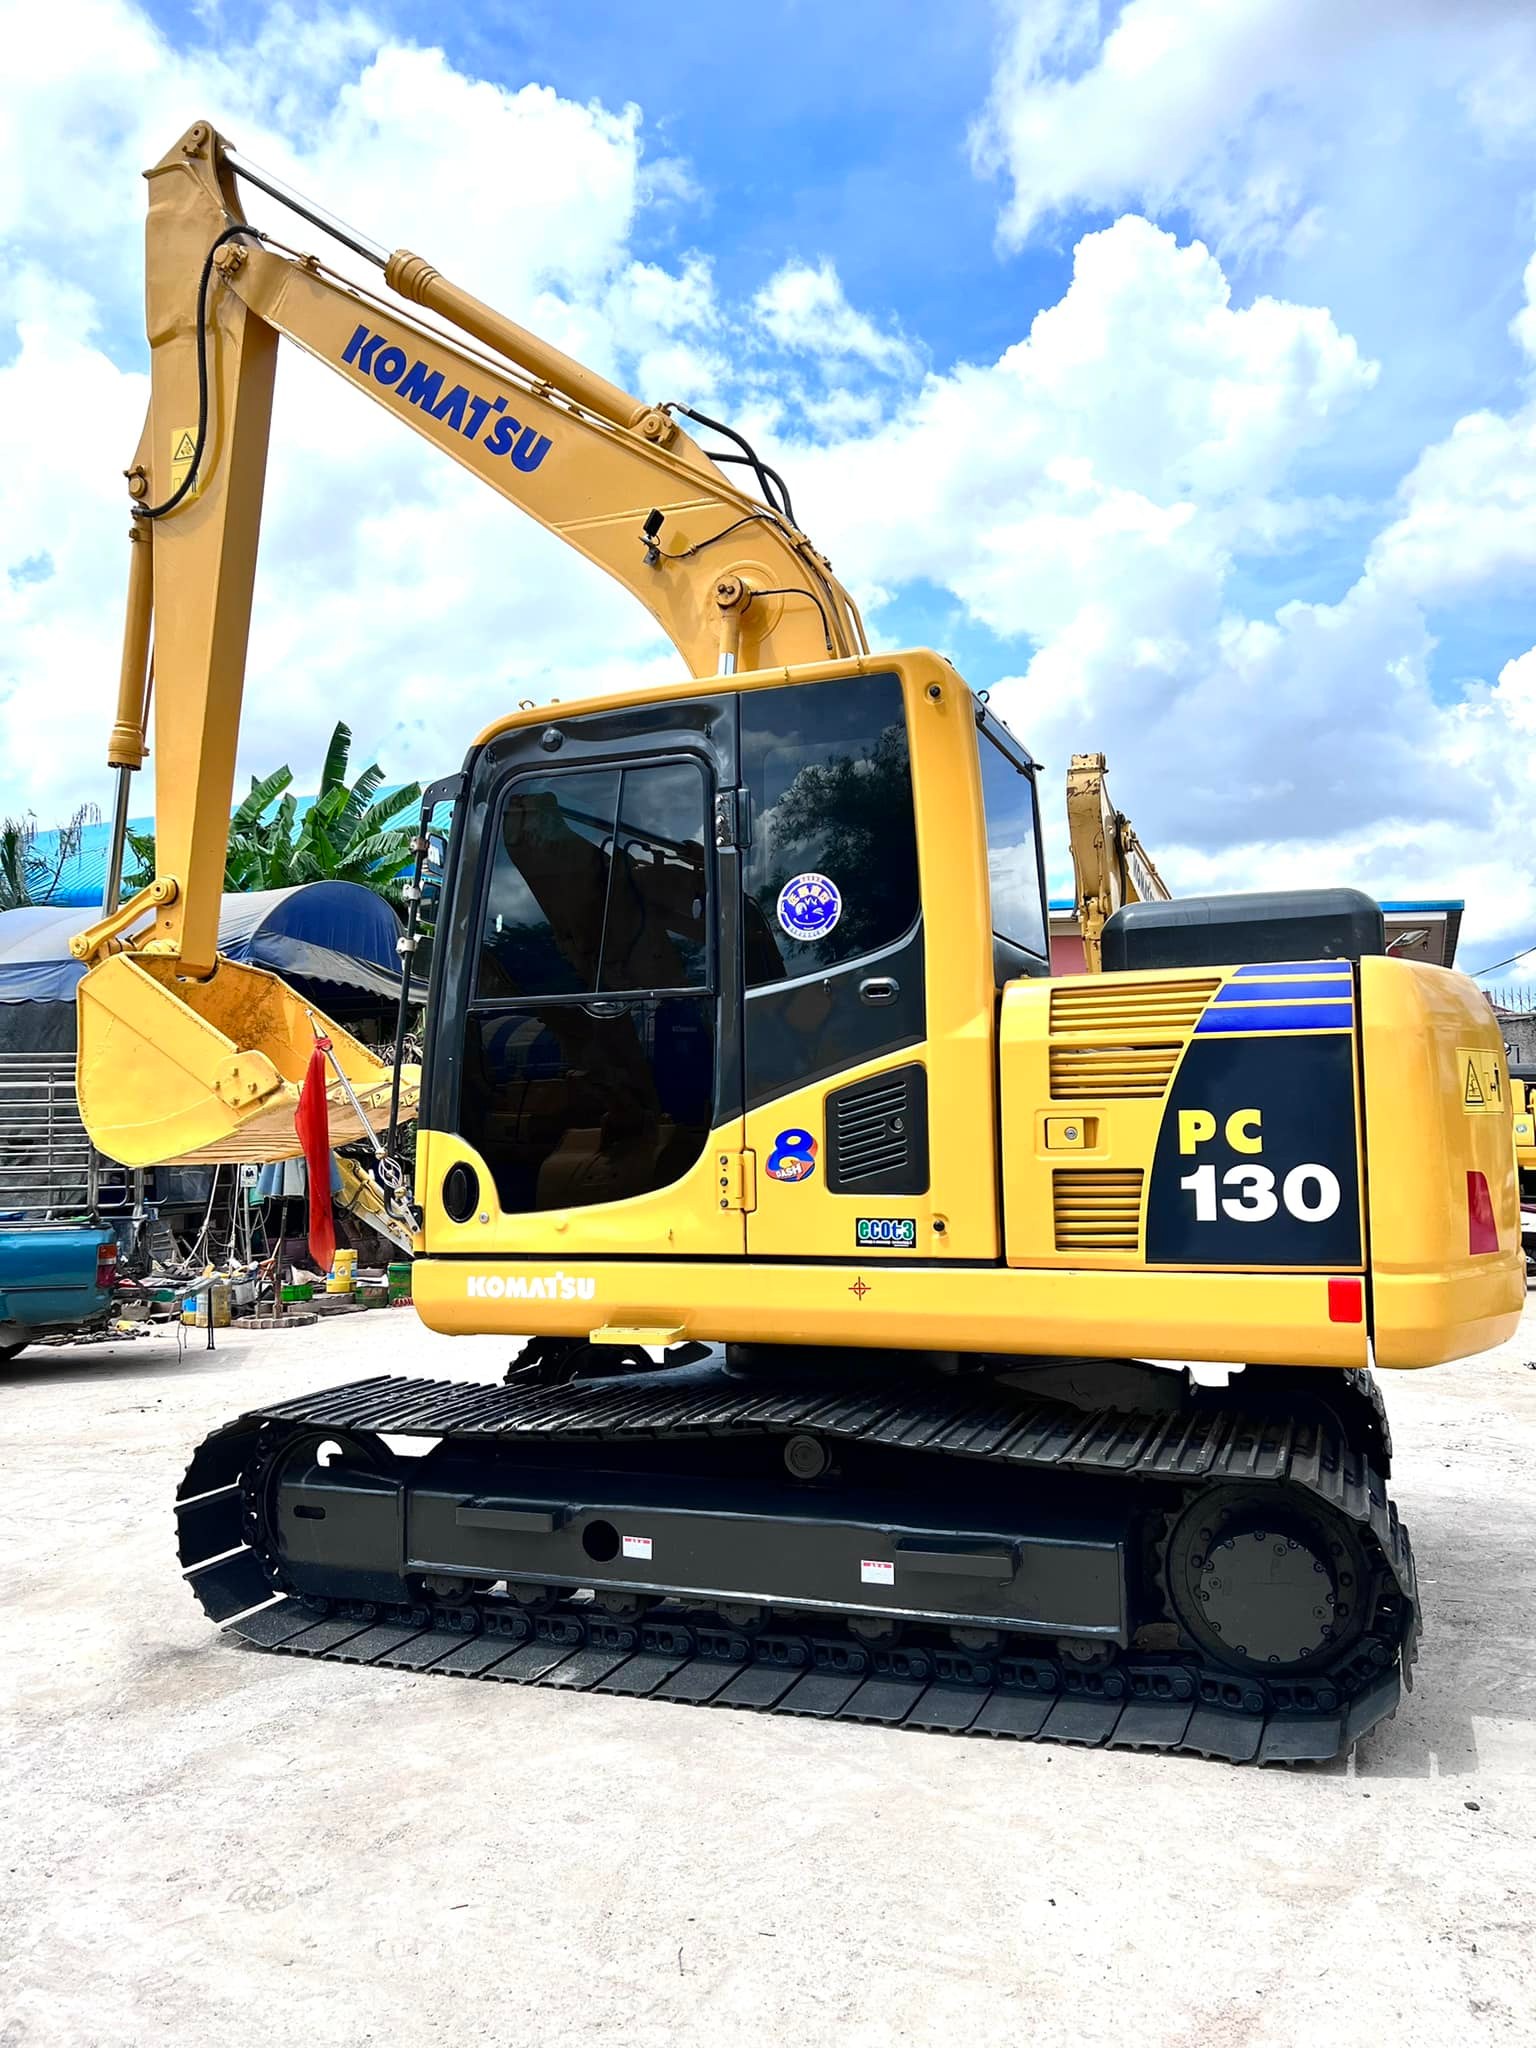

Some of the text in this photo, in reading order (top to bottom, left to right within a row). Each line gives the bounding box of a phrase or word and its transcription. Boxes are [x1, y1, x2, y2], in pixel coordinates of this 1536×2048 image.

[341, 324, 553, 473] KOMATSU
[765, 1128, 818, 1182] 8
[1177, 1108, 1263, 1155] PC
[775, 1163, 803, 1178] DASH
[1180, 1163, 1341, 1223] 130
[858, 1219, 914, 1240] ecot3
[466, 1271, 596, 1300] KOMATSU
